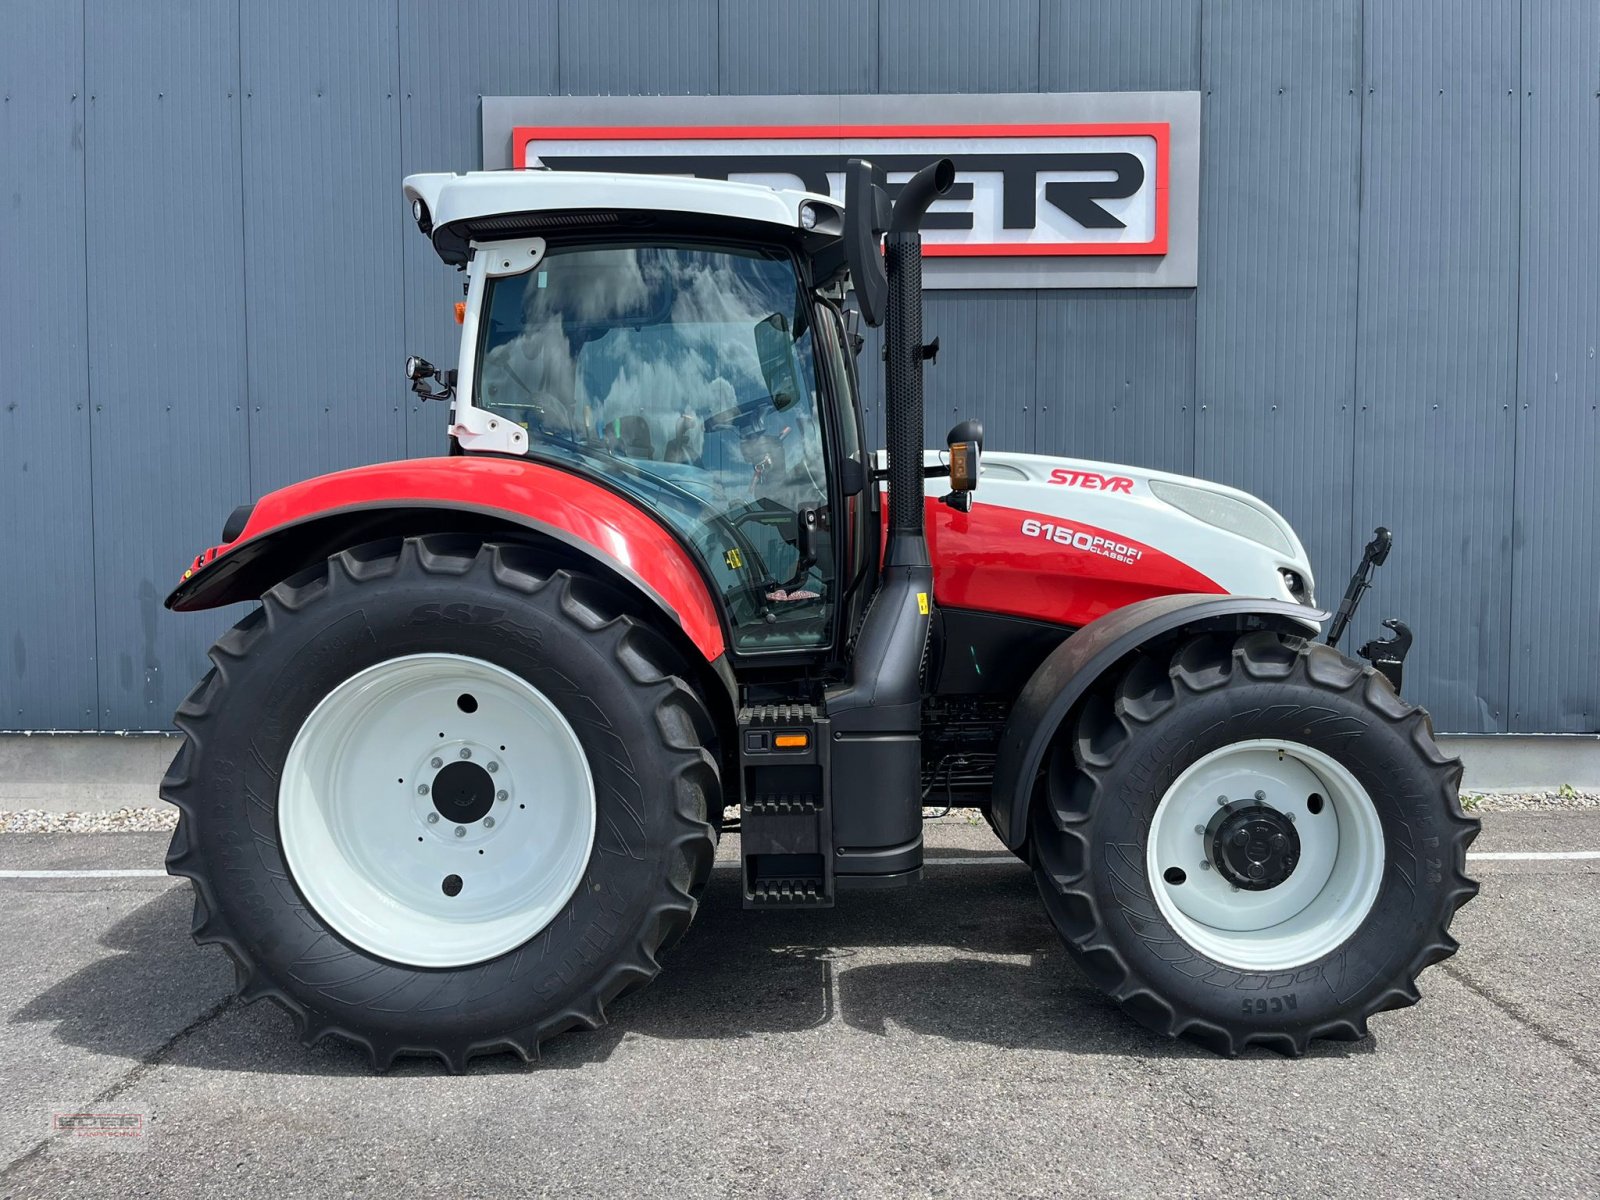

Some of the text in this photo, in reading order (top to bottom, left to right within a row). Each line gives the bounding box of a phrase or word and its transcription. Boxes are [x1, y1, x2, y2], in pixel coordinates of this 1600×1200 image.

[1048, 468, 1135, 495] STEYR
[1021, 519, 1143, 560] 6150 PROFI
[1089, 547, 1135, 565] CLASSIC
[1241, 993, 1297, 1015] AC65
